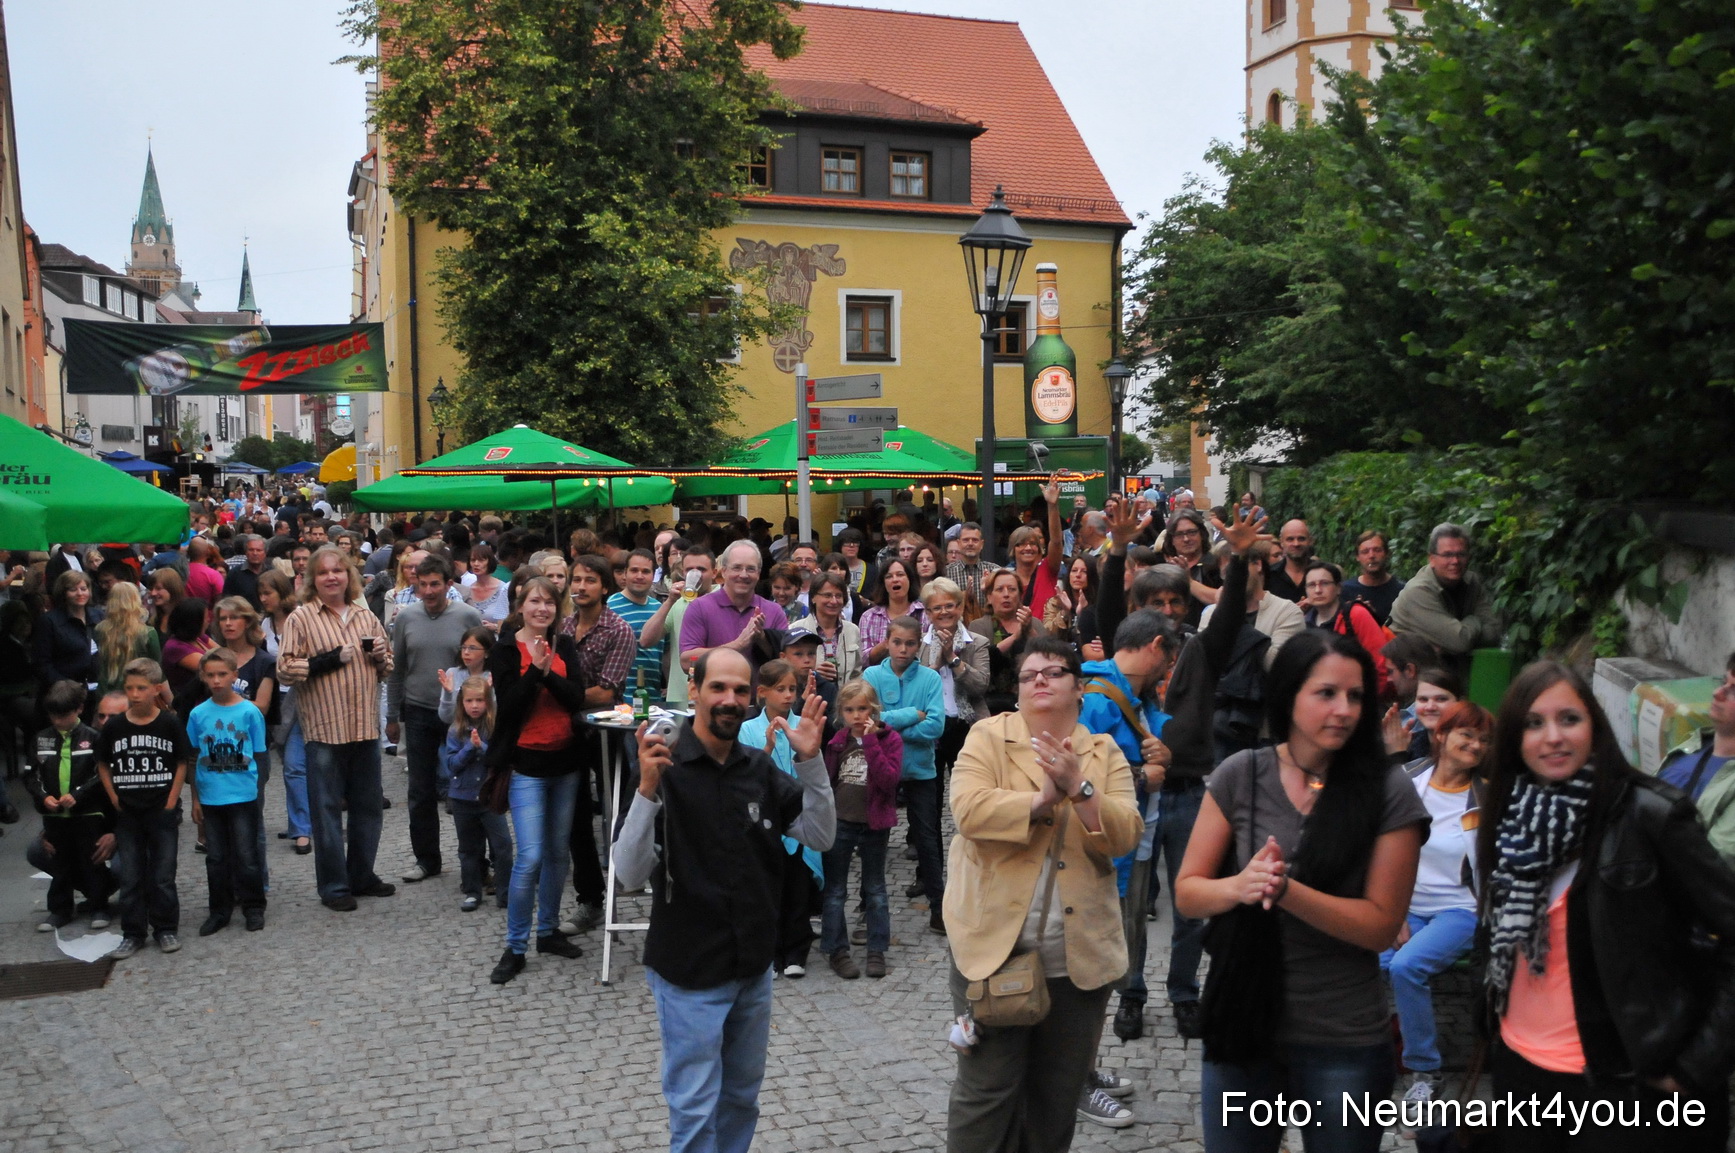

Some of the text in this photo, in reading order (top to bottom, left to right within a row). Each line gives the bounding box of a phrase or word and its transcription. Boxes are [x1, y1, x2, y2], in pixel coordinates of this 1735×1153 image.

[0, 473, 51, 485] räu
[113, 735, 173, 754] OS ANGELES
